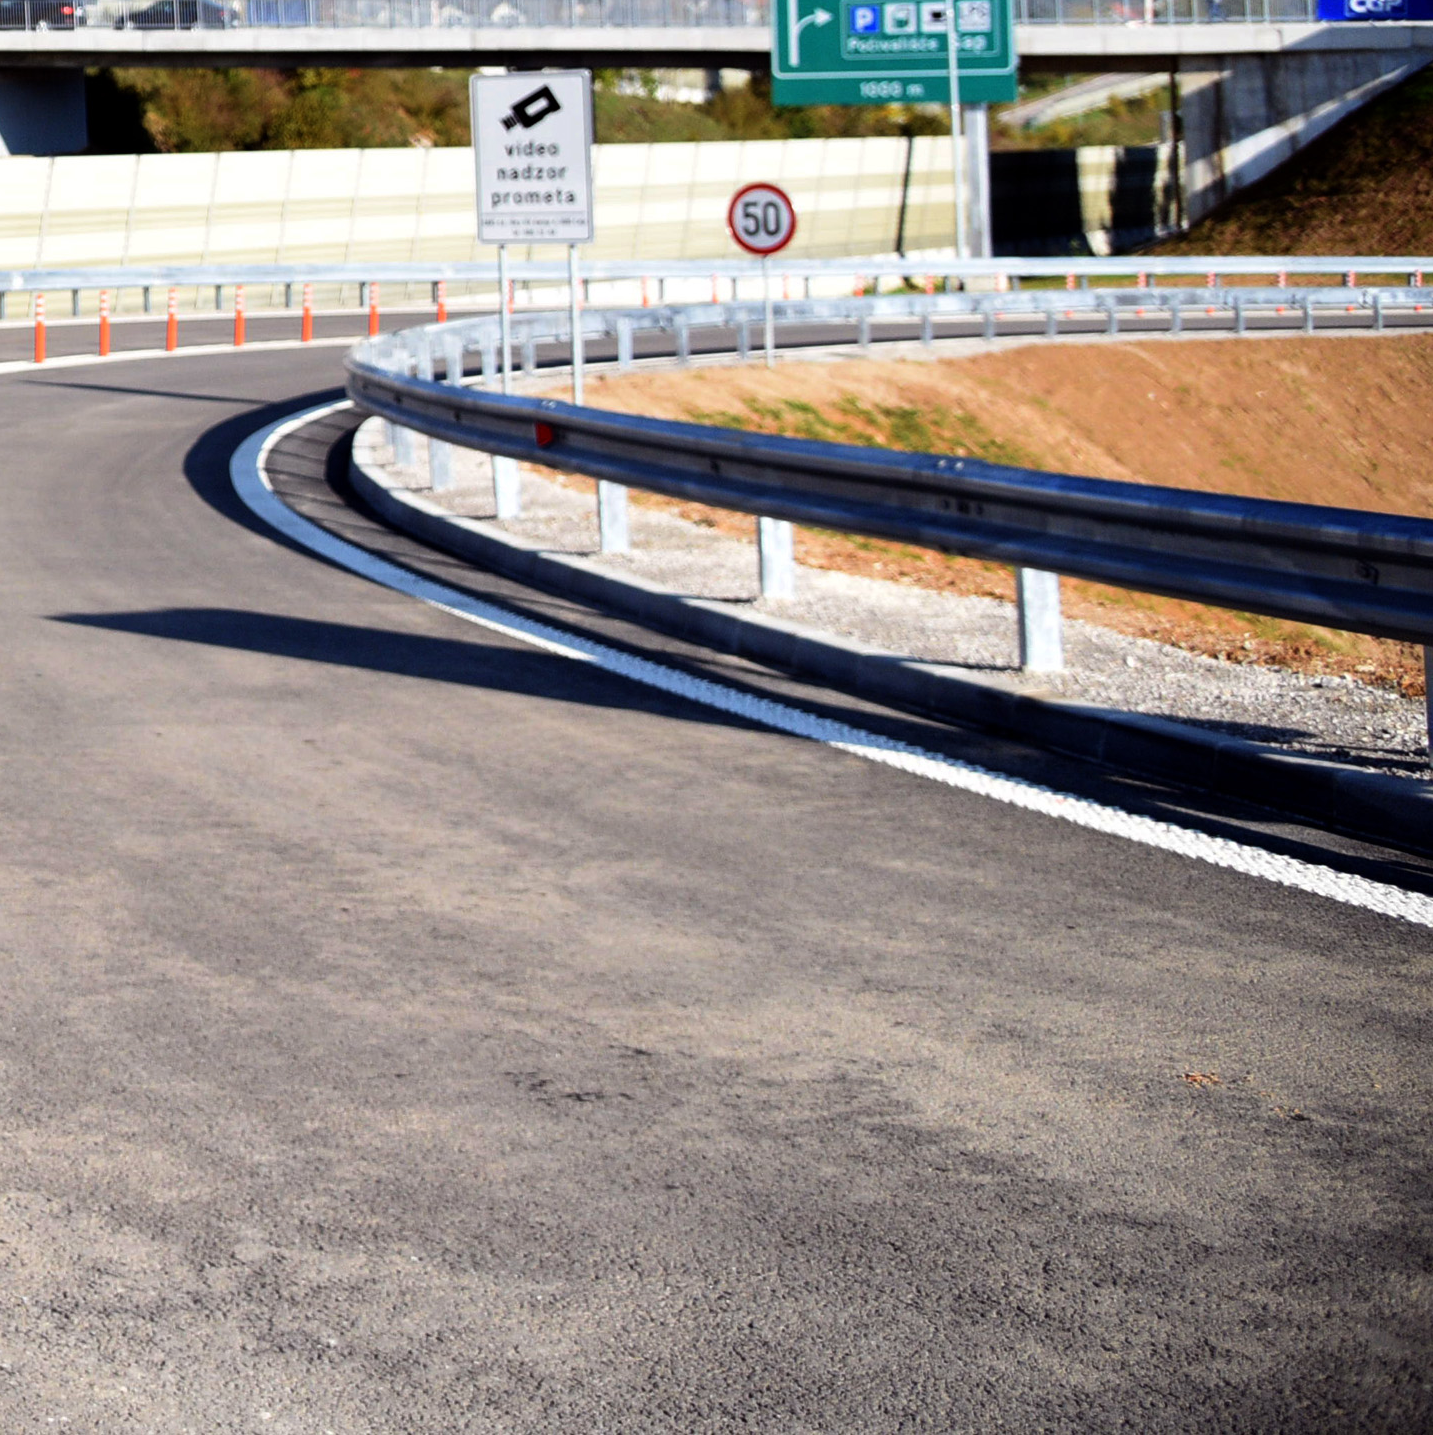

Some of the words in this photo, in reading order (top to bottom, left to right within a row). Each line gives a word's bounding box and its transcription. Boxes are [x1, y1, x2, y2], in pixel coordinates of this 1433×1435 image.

[854, 6, 874, 32] P
[860, 81, 903, 98] 1000
[505, 140, 559, 157] video
[497, 164, 566, 180] nadzor
[491, 187, 576, 208] prometa
[742, 201, 781, 236] 50
